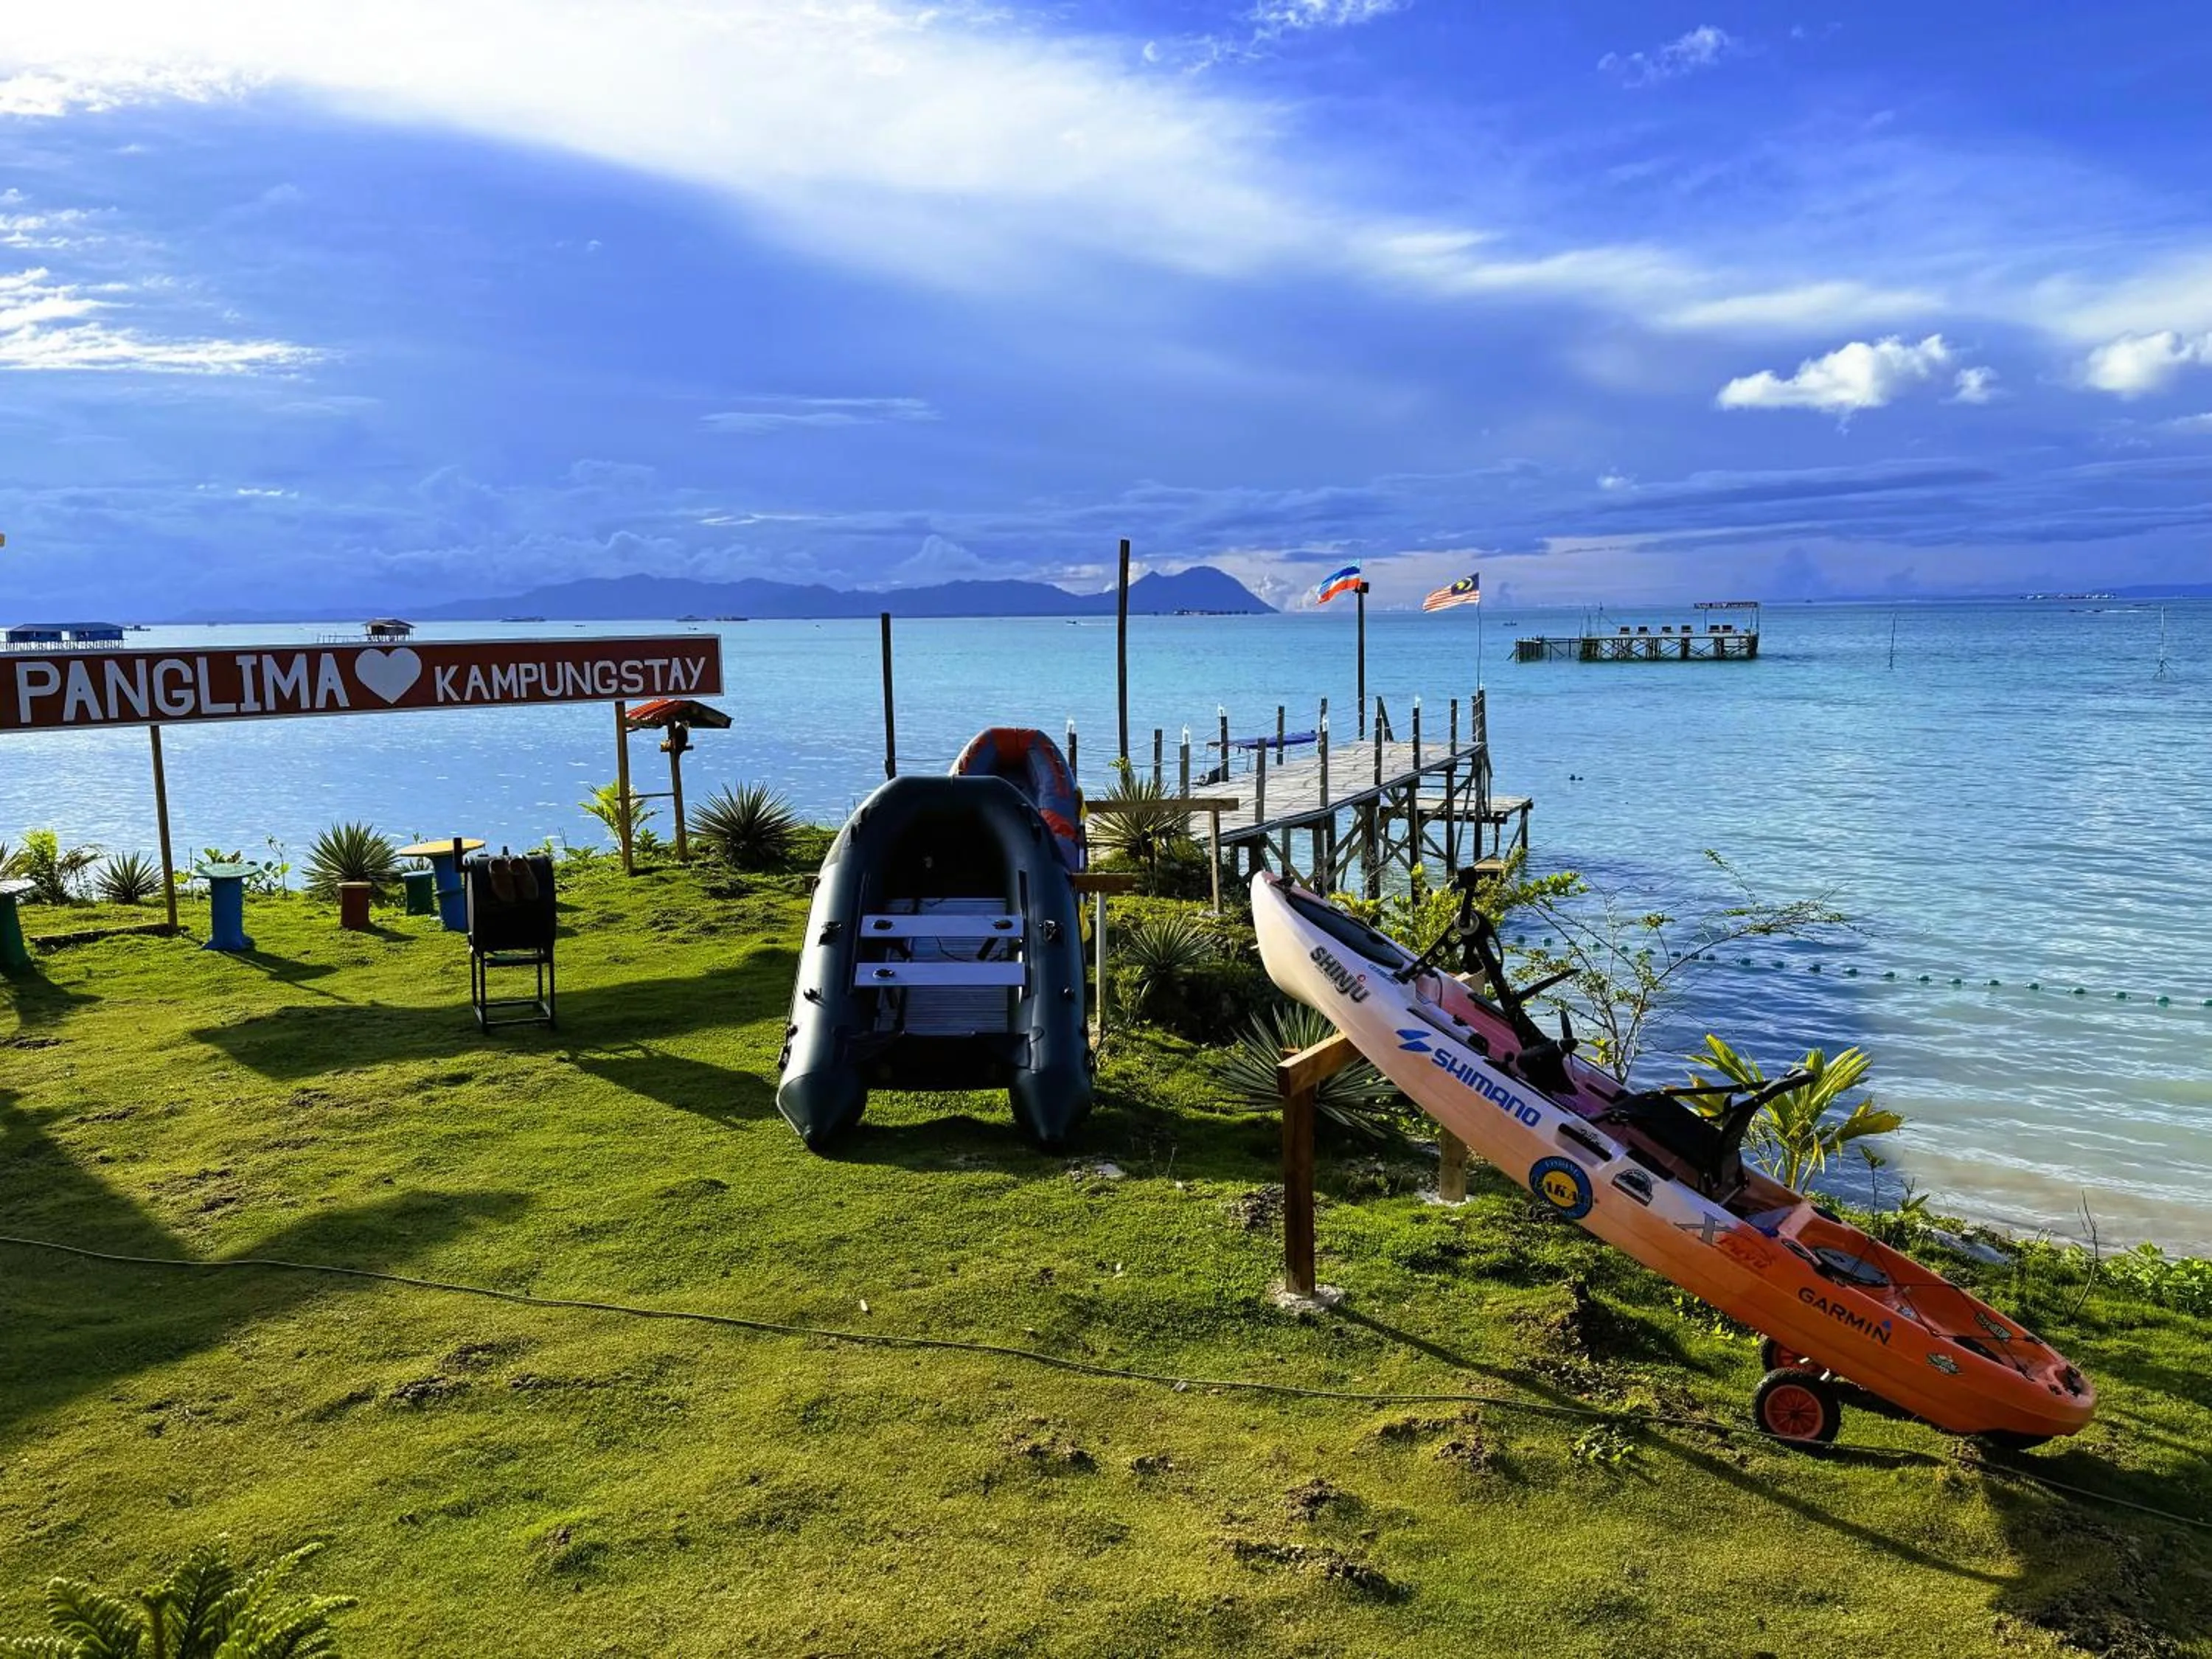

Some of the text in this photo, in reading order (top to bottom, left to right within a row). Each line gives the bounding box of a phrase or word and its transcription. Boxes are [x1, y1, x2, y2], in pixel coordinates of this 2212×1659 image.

[15, 652, 706, 724] PANGLIMA KAMPUNGSTAY
[1431, 1048, 1542, 1127] SHIMANO
[1798, 1287, 1892, 1346] GARMIN
